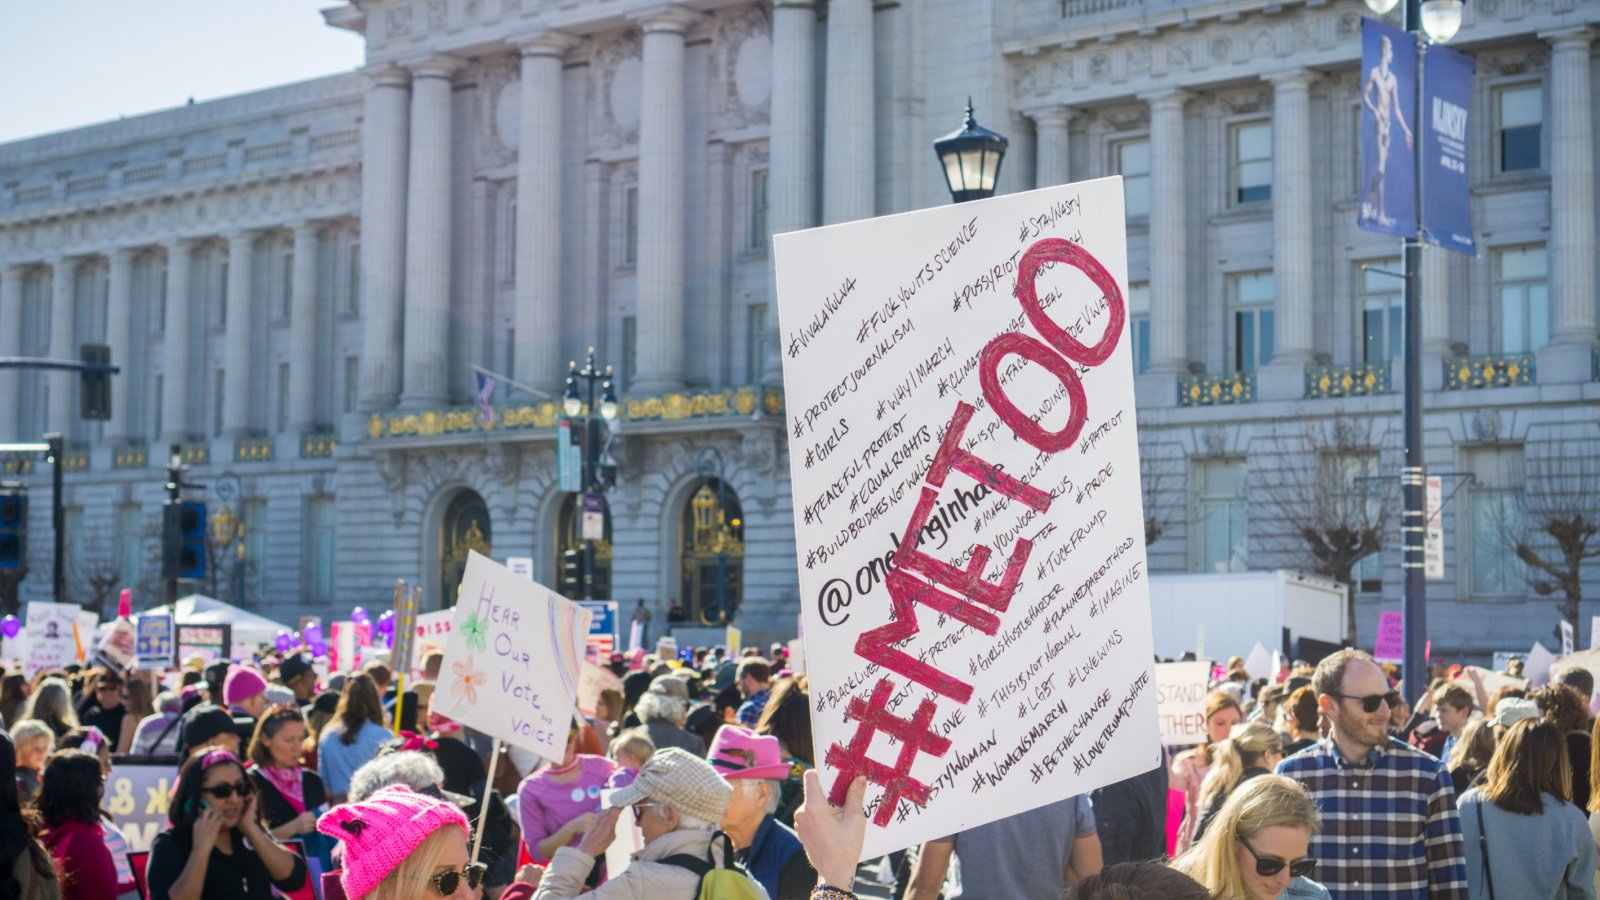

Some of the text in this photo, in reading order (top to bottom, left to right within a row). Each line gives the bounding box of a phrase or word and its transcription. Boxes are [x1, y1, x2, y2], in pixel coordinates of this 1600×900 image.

[1018, 193, 1081, 243] #STAYNASTY
[952, 249, 1021, 313] #PUSSYRIOT
[787, 277, 857, 359] #VIVALAVULVA
[793, 318, 916, 439] #PROTECTJOURNALISM
[804, 418, 849, 470] #GIRLS
[1080, 410, 1124, 455] #PATRIOT
[848, 424, 931, 515] #EQUALRIGHTS
[1075, 461, 1115, 505] #PRIDE
[824, 237, 1126, 828] #METOO
[1036, 509, 1108, 581] #TUCKFRUMP
[1042, 537, 1135, 635] #PLANNEDPARENTHOOD
[1089, 561, 1142, 619] #IMAGINE
[968, 583, 1065, 677] #GIRLSHUSTLEHARDER
[1067, 629, 1124, 689] #LOVEWINS
[1018, 672, 1057, 719] #LGBT
[1074, 670, 1150, 777] #LOVETRUMPSHATE
[1157, 682, 1204, 705] STAND
[1158, 712, 1207, 736] THER
[971, 699, 1069, 794] #WOMENSMARCH
[1030, 688, 1112, 785] #BETHECHANGE
[896, 728, 998, 825] #NSTYWOMAN
